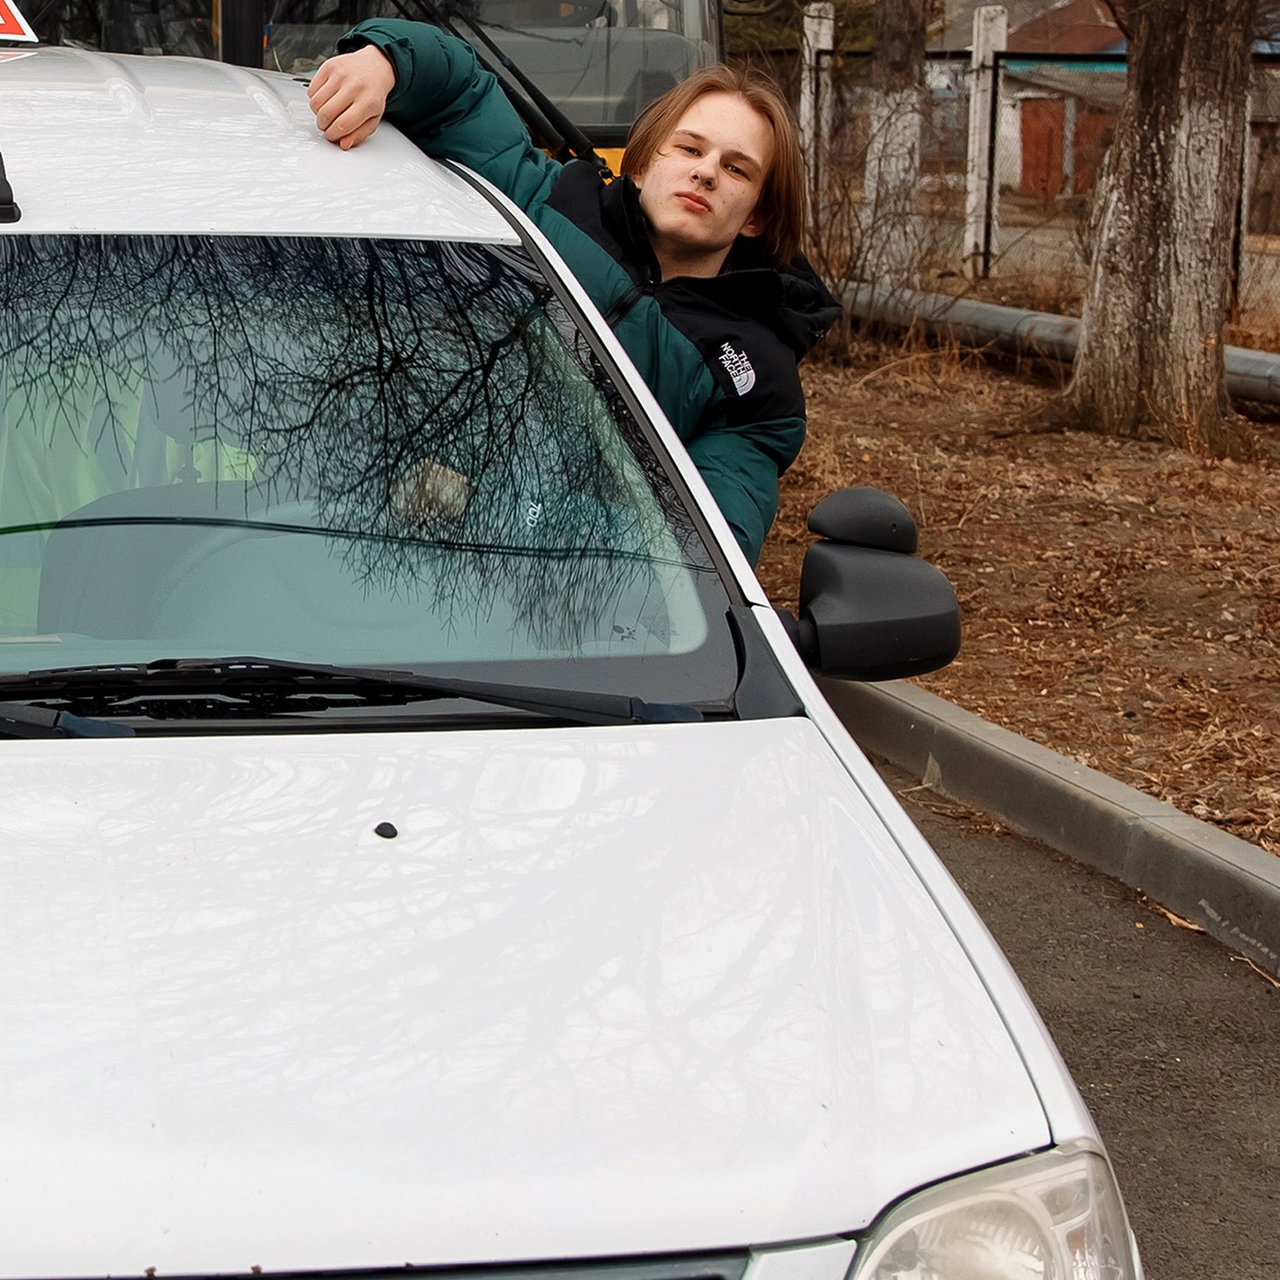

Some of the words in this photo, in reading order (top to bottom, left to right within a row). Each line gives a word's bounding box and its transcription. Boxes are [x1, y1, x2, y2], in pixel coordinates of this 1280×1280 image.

[718, 353, 739, 379] FACE
[720, 341, 747, 376] NORTH
[738, 349, 753, 372] THE
